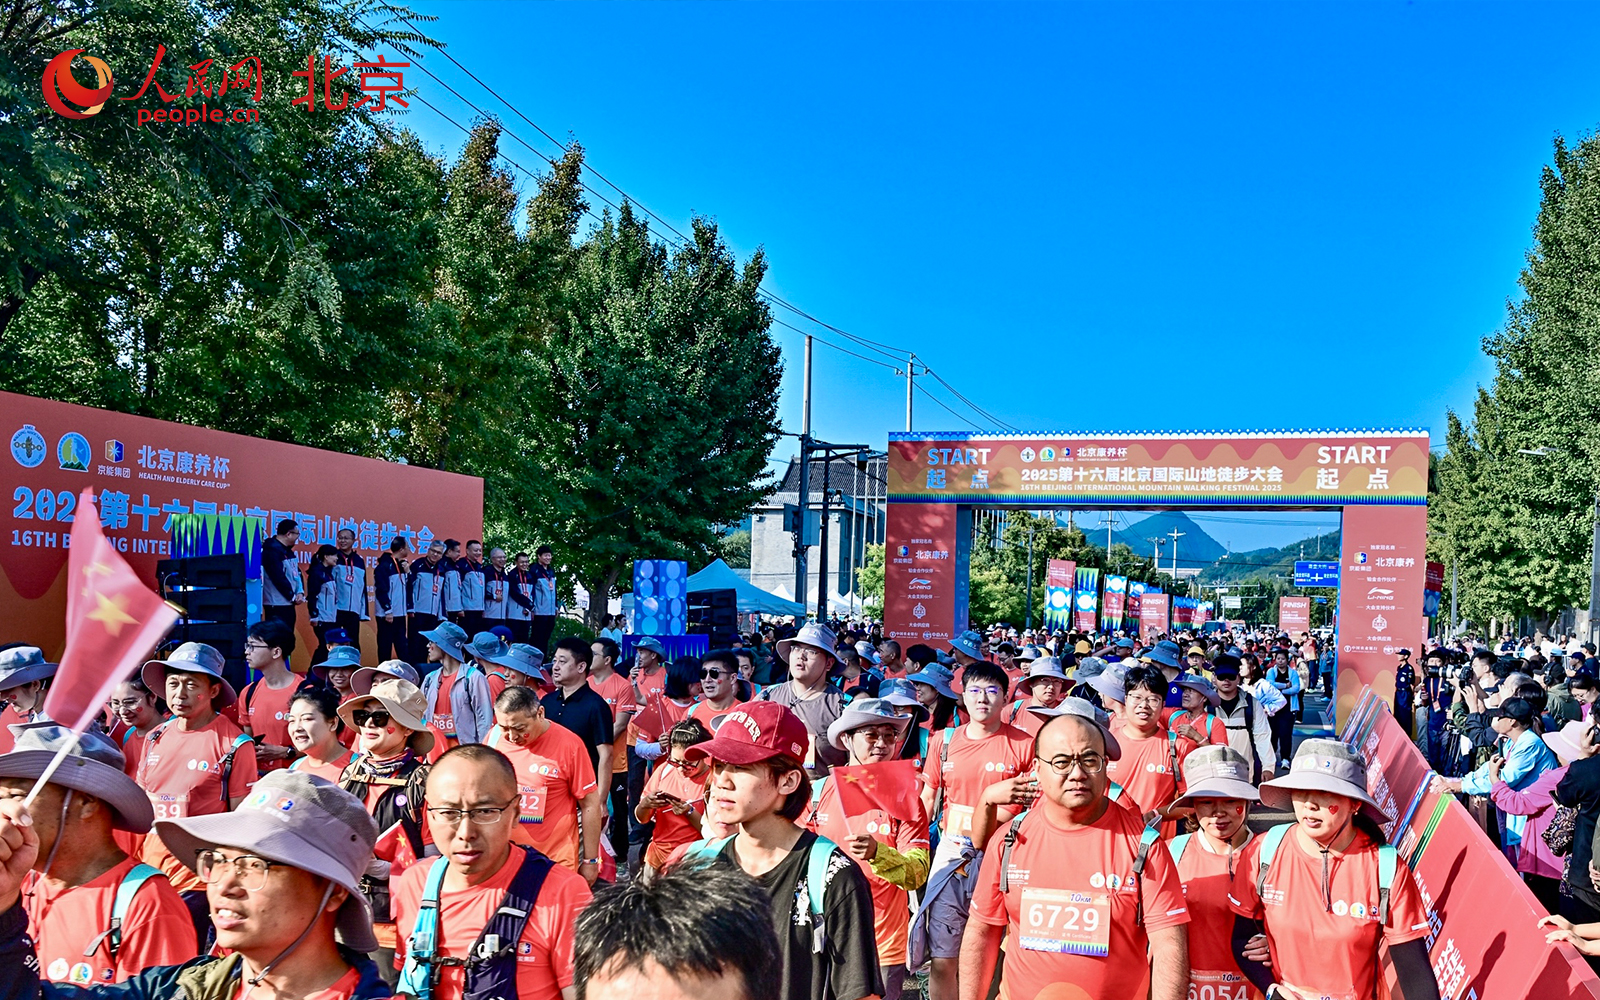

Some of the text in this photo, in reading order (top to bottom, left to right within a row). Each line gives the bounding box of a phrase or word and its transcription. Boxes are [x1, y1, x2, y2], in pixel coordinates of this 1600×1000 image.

[927, 448, 992, 465] START
[1077, 447, 1128, 458] 北京康养杯
[1317, 445, 1392, 464] START
[137, 445, 231, 479] 北京康养杯
[97, 464, 131, 479] 京能集团
[138, 472, 162, 481] HEALTH
[162, 475, 175, 483] AND
[176, 477, 200, 486] ELDERLY
[200, 480, 215, 488] CARE
[1021, 465, 1284, 483] 2025第十六届北京国际山地徒步大会
[11, 529, 57, 548] 16TH
[915, 550, 949, 559] 北京康养
[1375, 557, 1415, 567] 北京康养
[1028, 903, 1100, 932] 6729
